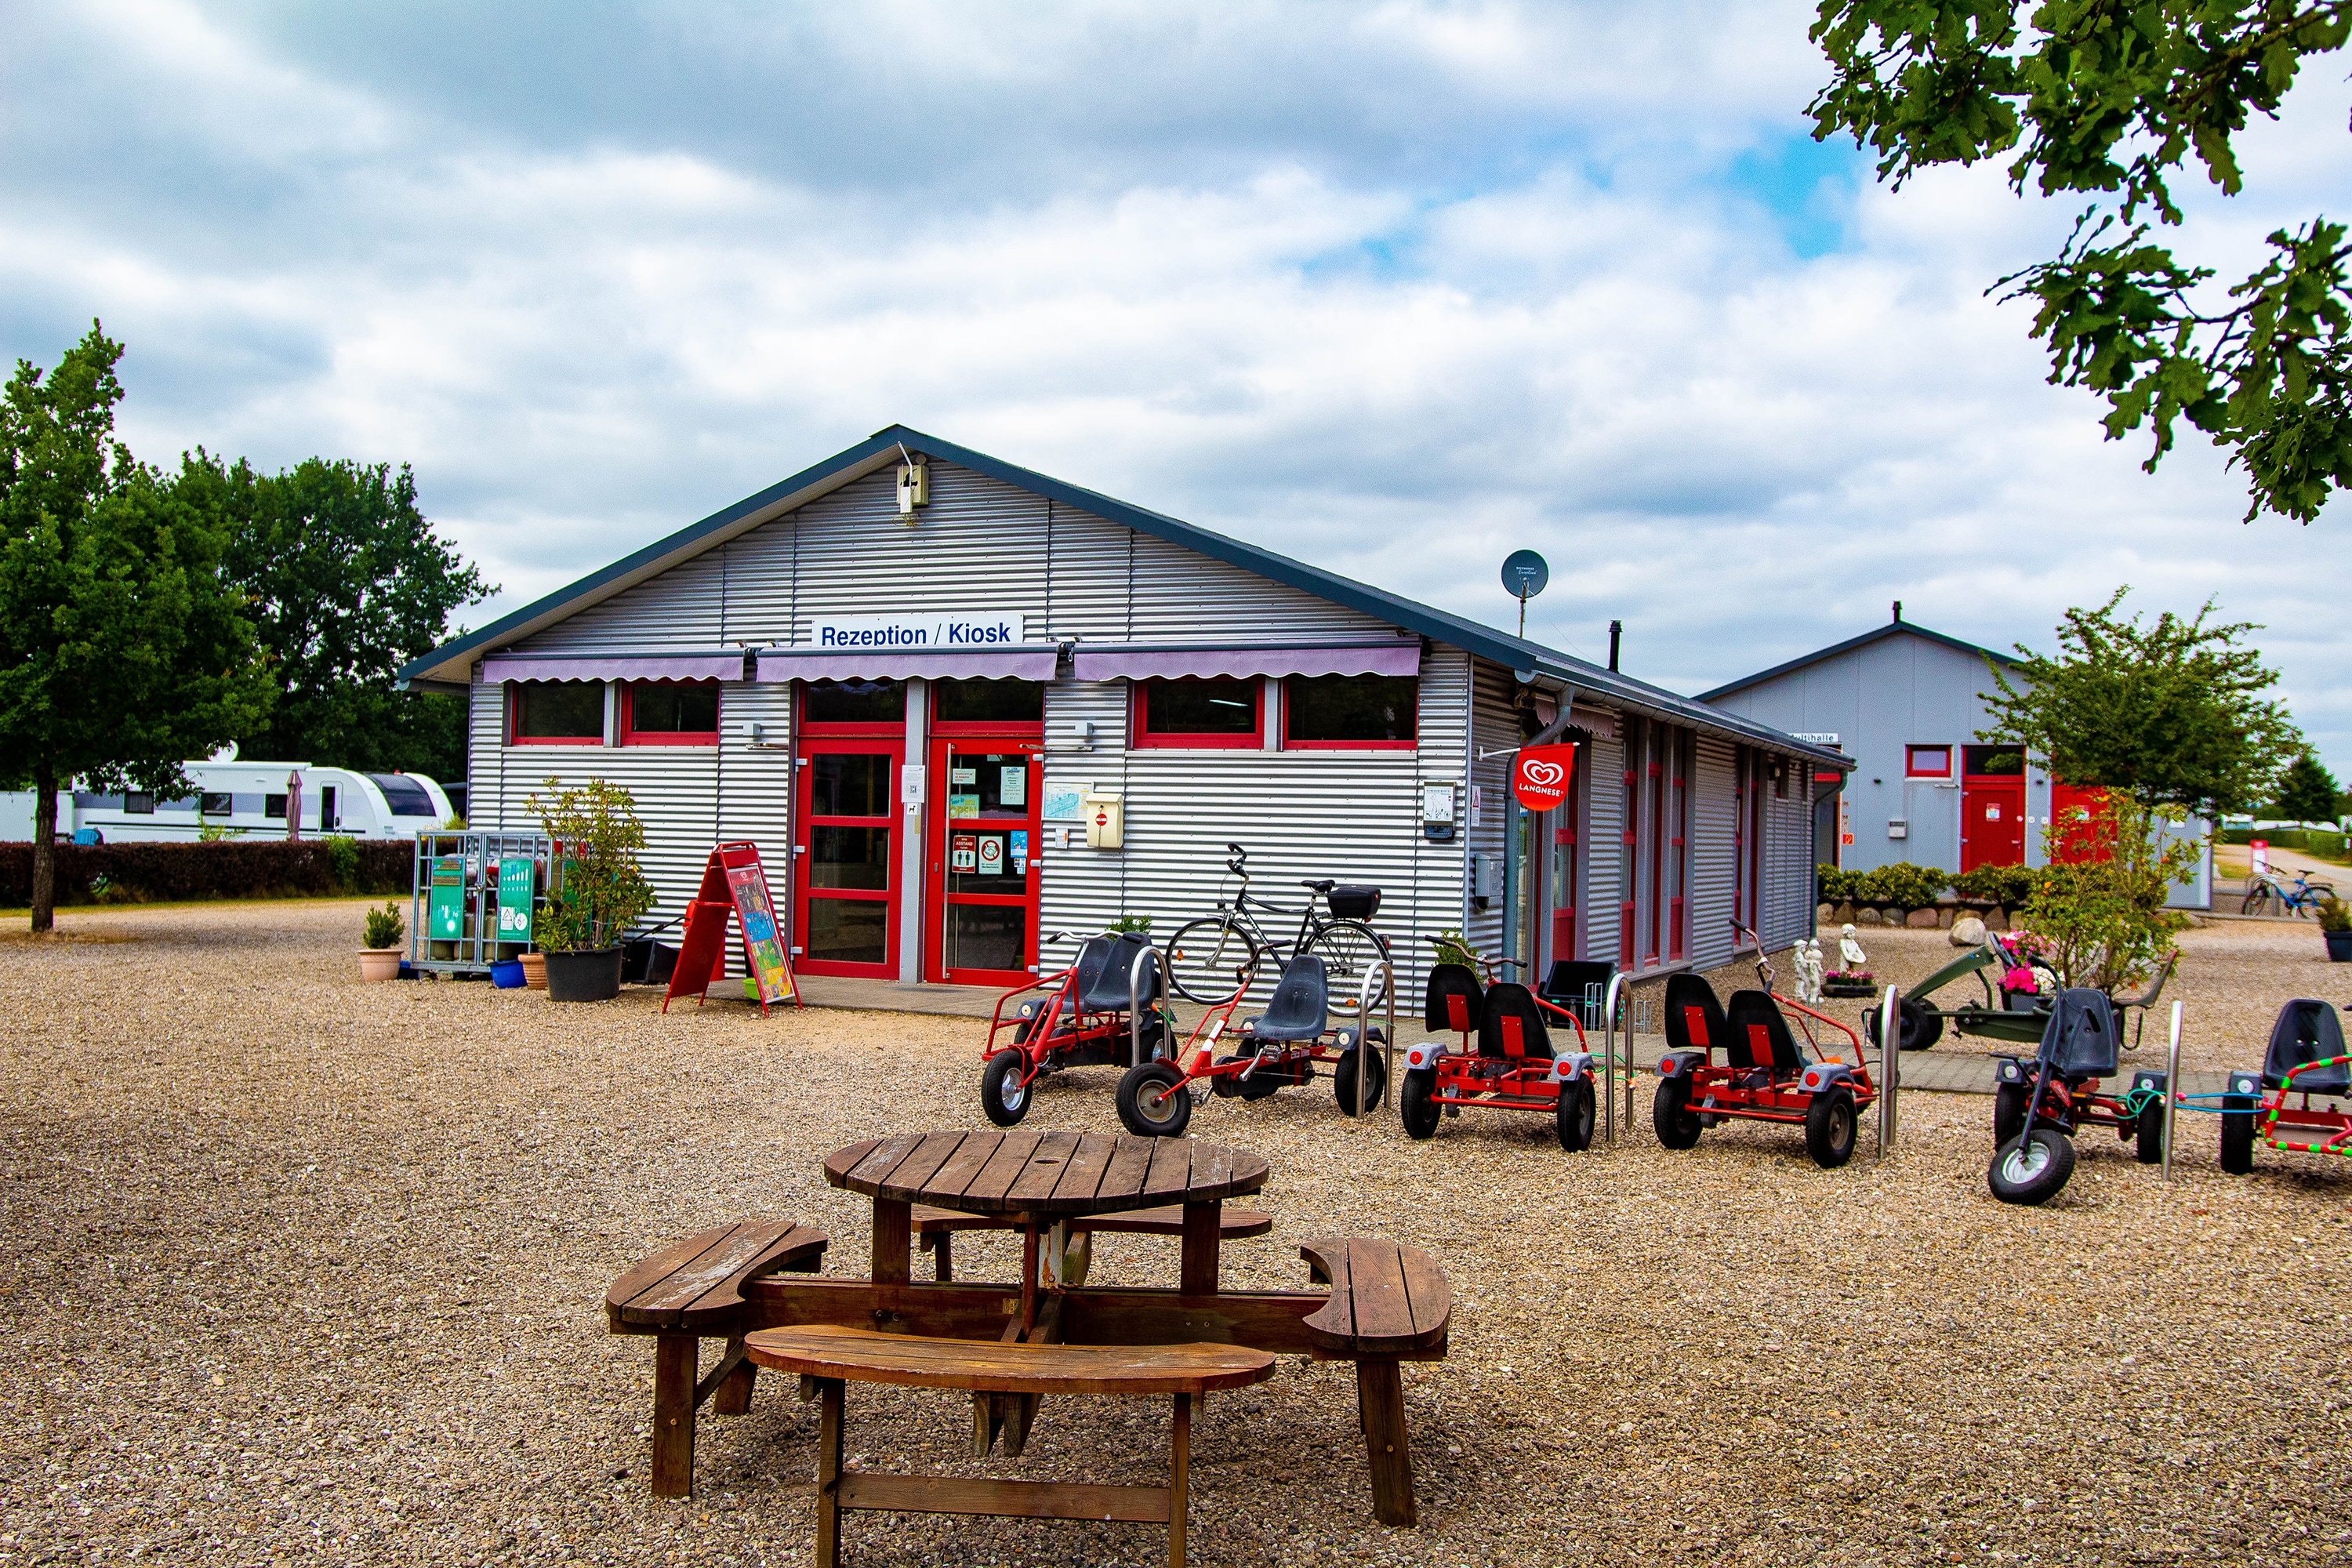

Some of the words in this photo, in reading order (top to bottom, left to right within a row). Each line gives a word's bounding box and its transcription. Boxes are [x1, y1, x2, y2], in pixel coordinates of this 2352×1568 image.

[822, 625, 927, 646] Rezeption
[934, 623, 942, 645] /
[949, 622, 1011, 644] Kiosk
[1519, 782, 1561, 797] LANGNESE
